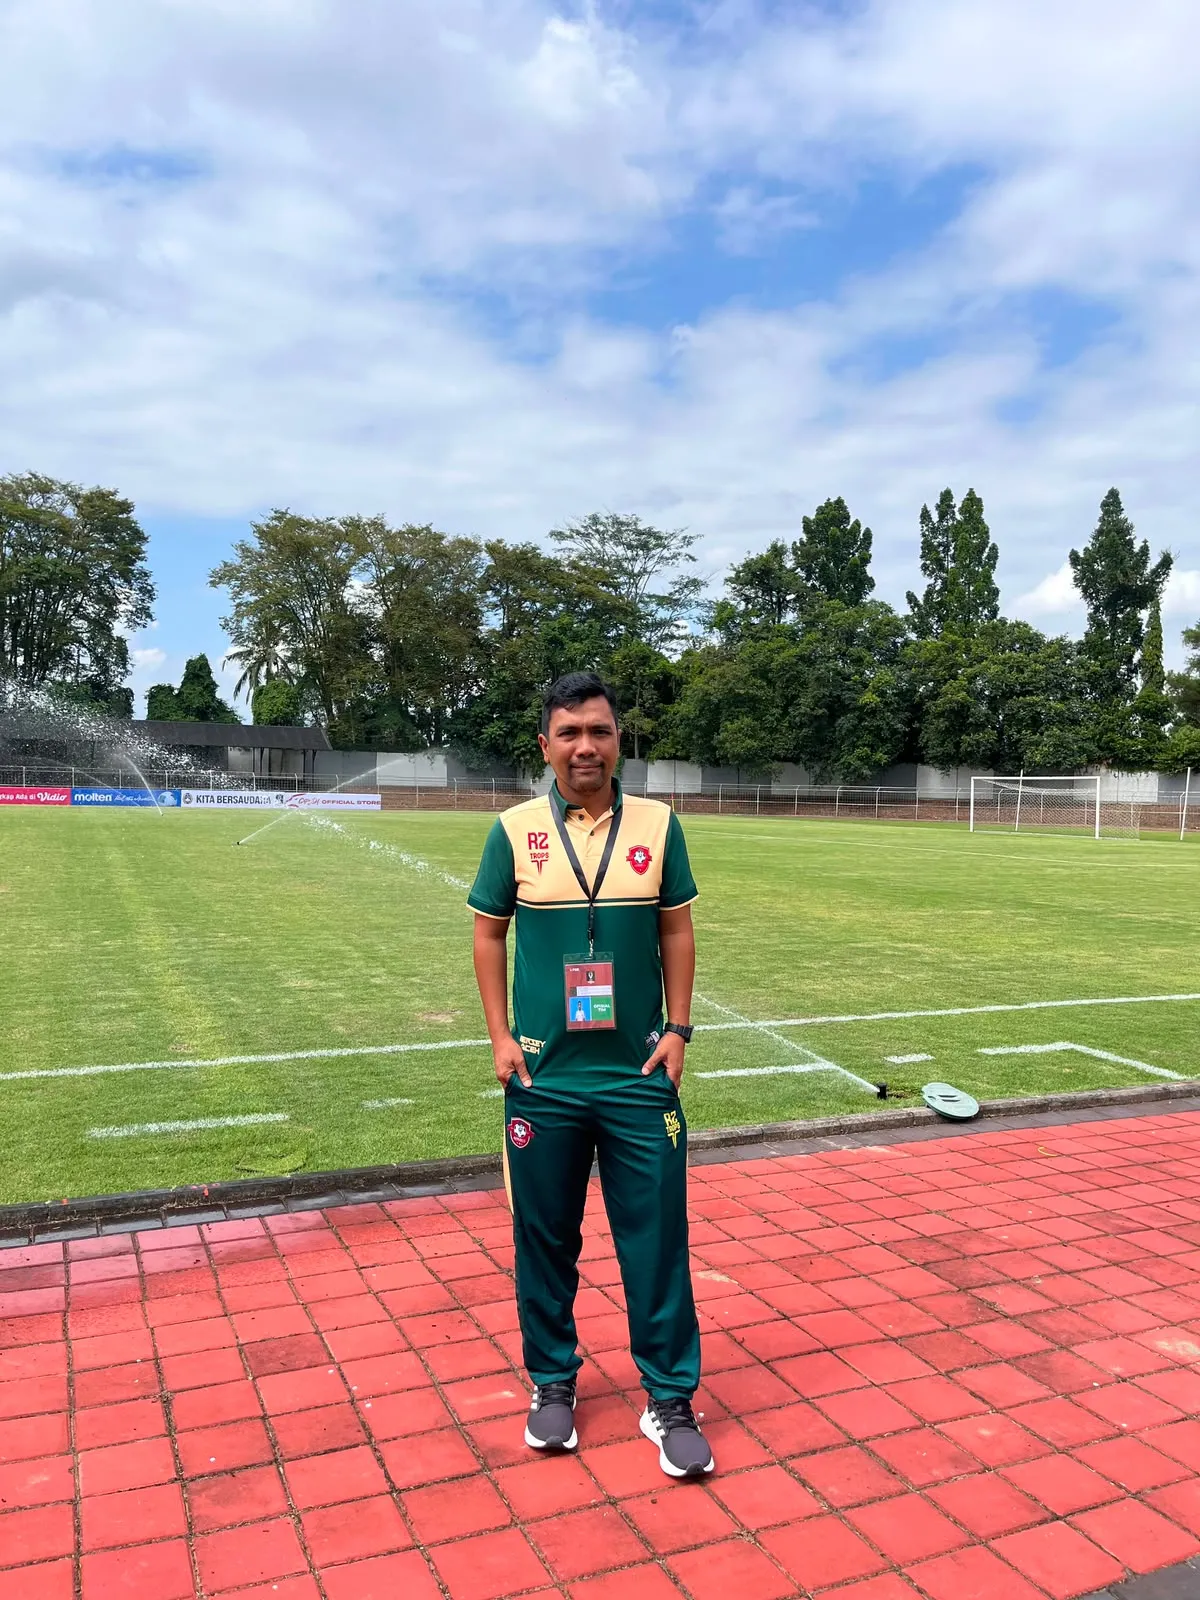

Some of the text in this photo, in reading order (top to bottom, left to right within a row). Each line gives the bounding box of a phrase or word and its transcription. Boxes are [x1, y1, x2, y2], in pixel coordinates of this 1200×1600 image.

[36, 792, 67, 802] Vidio
[74, 793, 112, 802] molten
[196, 794, 215, 804] KITA
